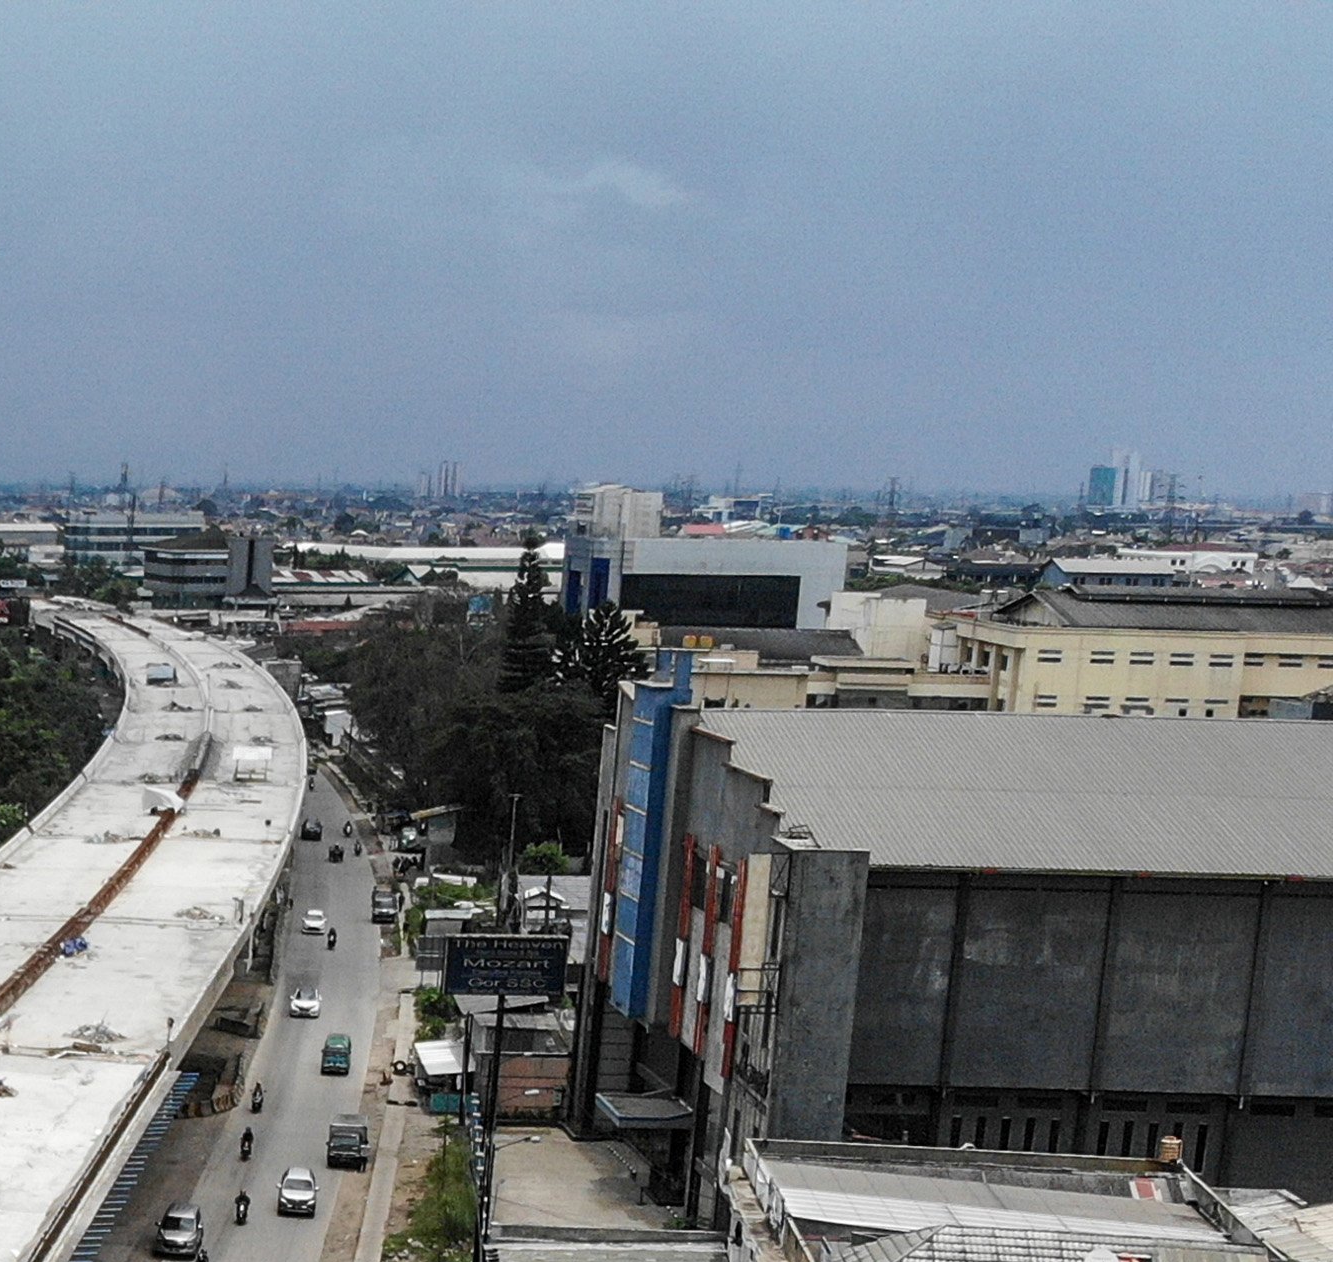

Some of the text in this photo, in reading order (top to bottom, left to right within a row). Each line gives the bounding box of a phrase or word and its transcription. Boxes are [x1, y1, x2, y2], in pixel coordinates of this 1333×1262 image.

[456, 939, 564, 949] The Heaven
[463, 958, 550, 969] Mozart
